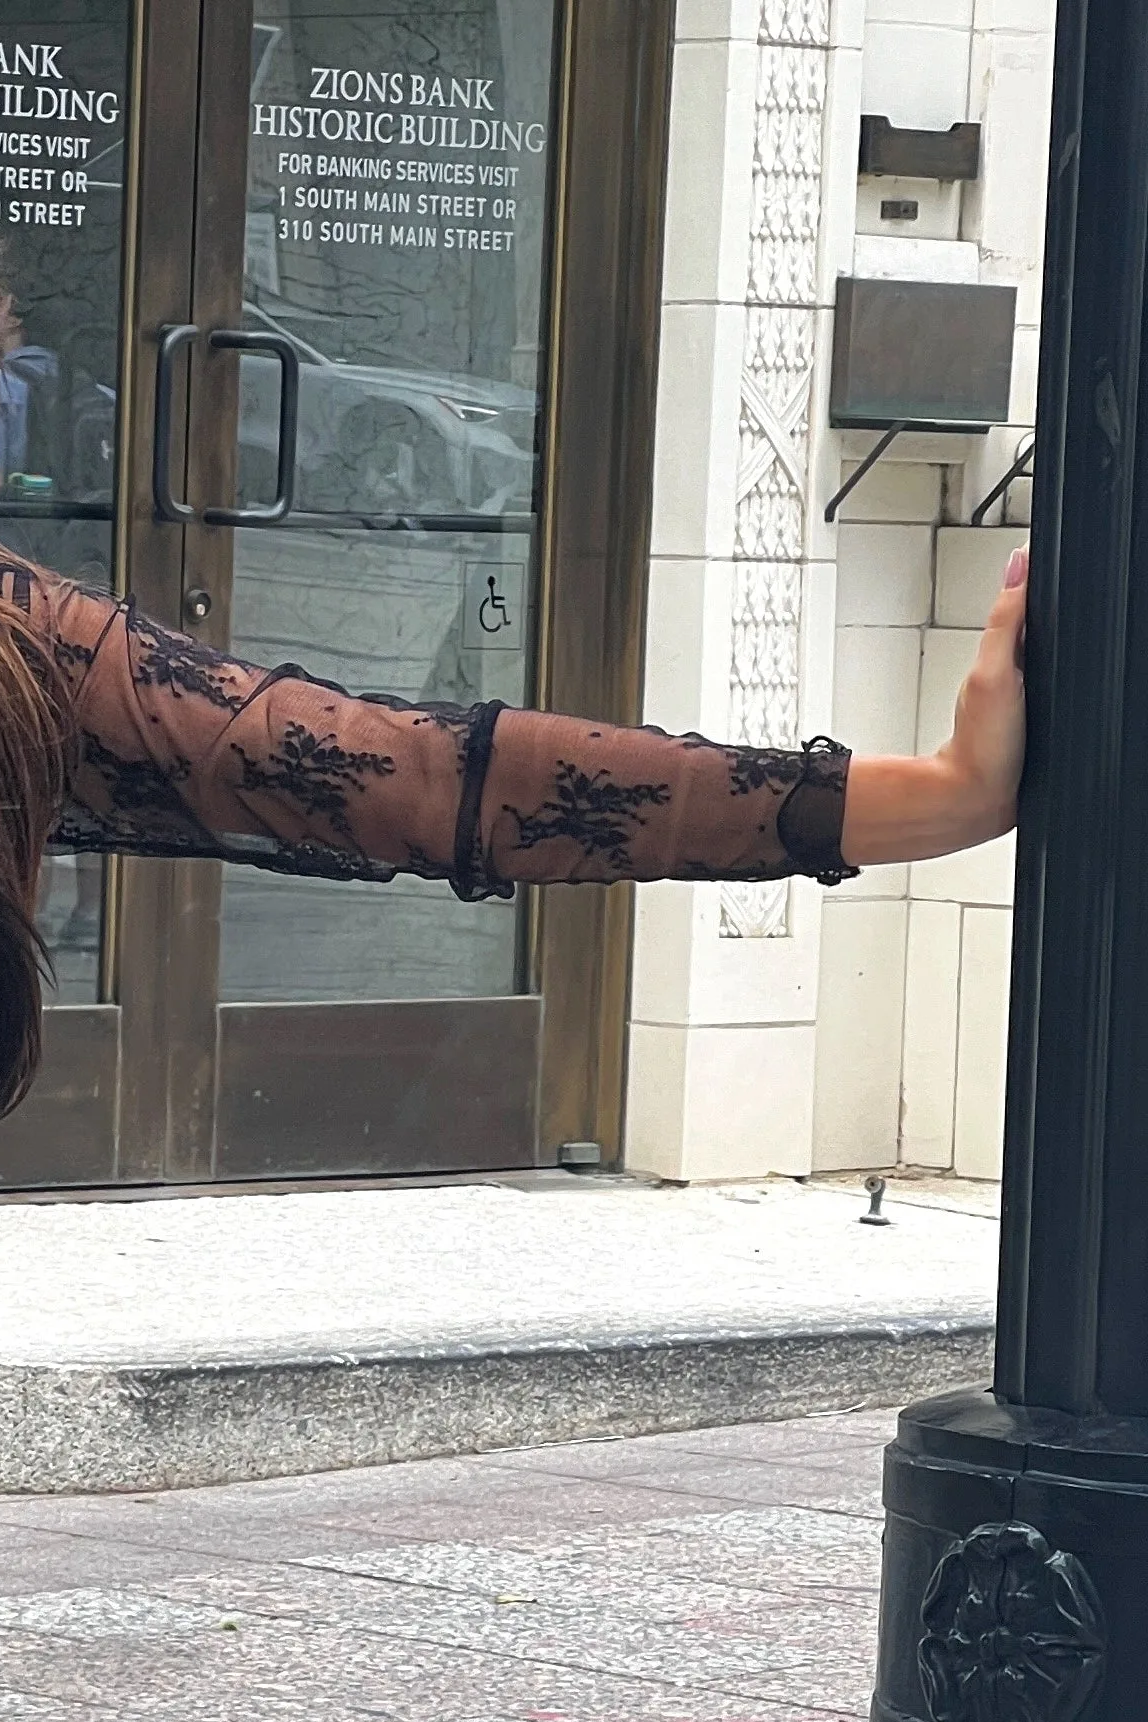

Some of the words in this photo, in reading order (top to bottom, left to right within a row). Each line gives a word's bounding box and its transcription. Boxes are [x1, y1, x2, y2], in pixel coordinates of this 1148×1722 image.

[310, 67, 403, 104] ZIONS
[409, 74, 494, 111] BANK
[252, 104, 393, 144] HISTORIC
[400, 114, 548, 152] BUILDING
[46, 136, 91, 159] VISIT
[61, 171, 88, 193] OR
[278, 152, 312, 175] FOR
[316, 155, 391, 180] BANKING
[395, 160, 475, 185] SERVICES
[479, 165, 519, 187] VISIT
[8, 201, 86, 226] STREET
[278, 186, 286, 207] 1
[294, 187, 357, 210] SOUTH
[364, 191, 410, 213] MAIN
[416, 194, 487, 218] STREET
[492, 198, 517, 220] OR
[278, 219, 313, 241] 310
[319, 221, 383, 245] SOUTH
[390, 225, 437, 248] MAIN
[443, 228, 514, 252] STREET
